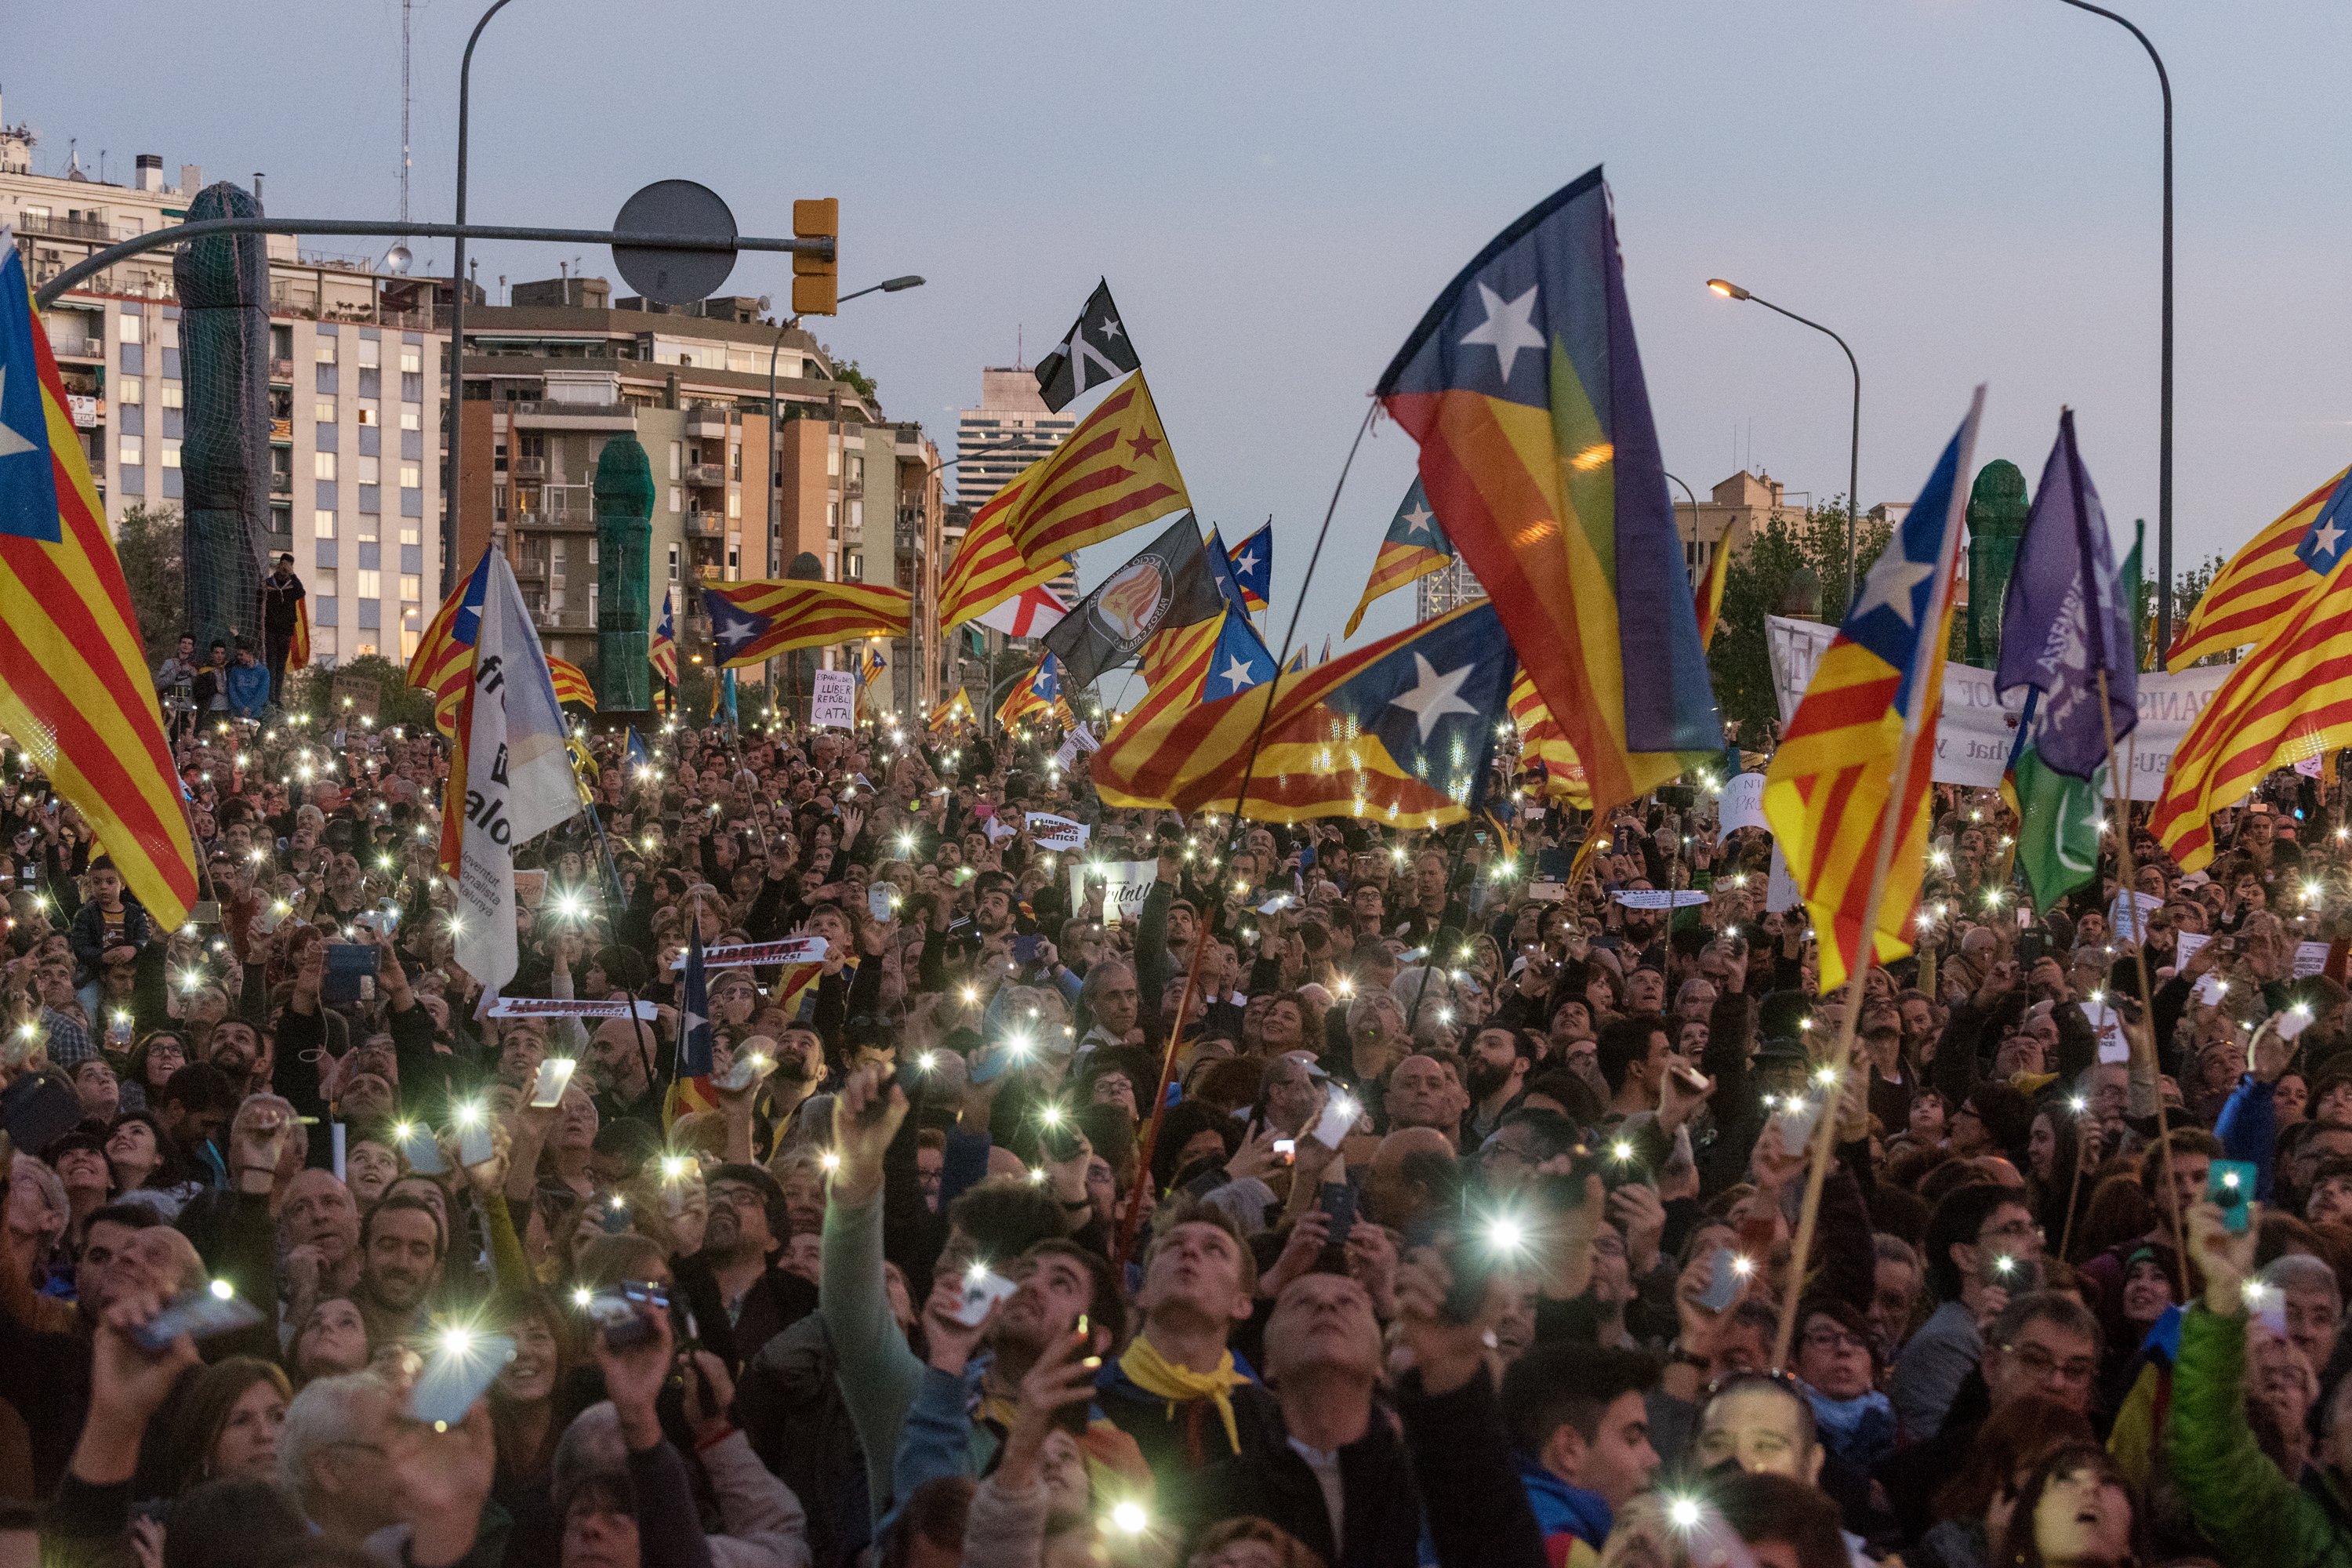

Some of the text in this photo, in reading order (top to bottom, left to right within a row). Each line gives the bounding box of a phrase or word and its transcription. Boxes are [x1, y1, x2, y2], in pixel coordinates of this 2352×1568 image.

[476, 655, 506, 713] fr
[822, 683, 853, 695] LLIBER
[817, 694, 851, 704] REPÚBLI
[815, 707, 851, 720] CATAL
[1736, 795, 1762, 814] PRO
